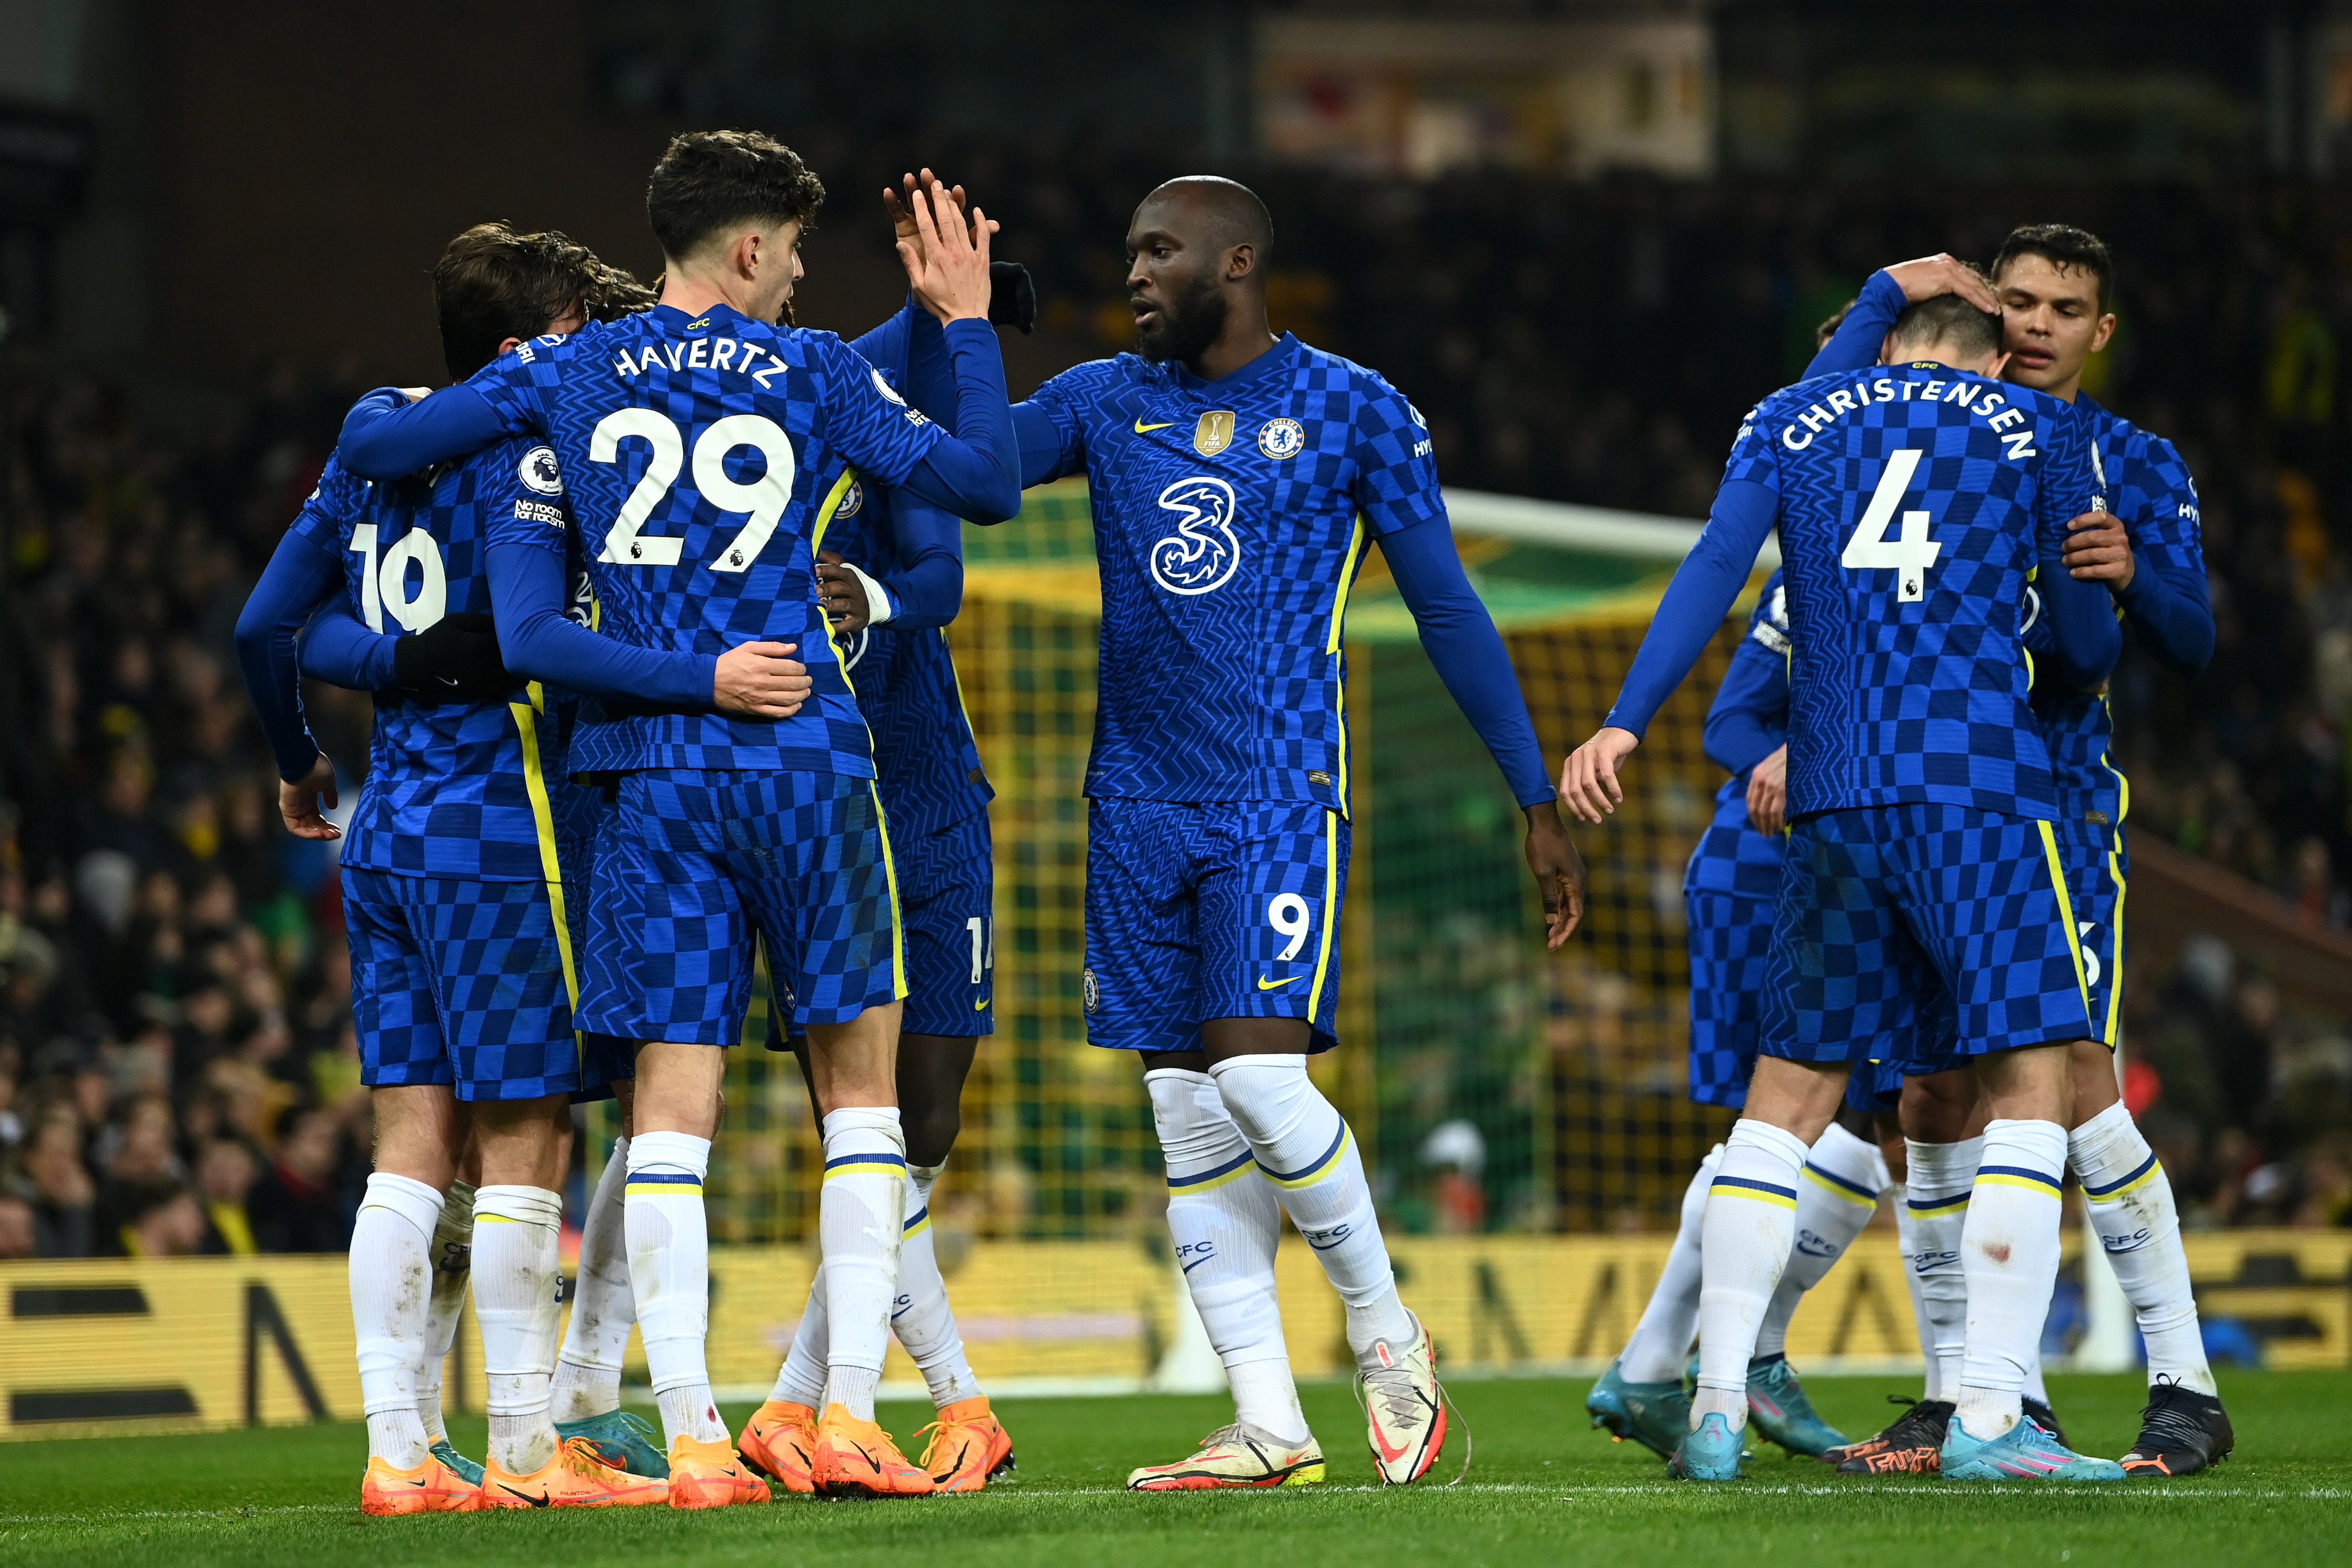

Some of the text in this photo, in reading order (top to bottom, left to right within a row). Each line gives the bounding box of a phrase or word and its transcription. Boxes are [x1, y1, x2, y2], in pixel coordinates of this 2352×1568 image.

[687, 318, 710, 330] CFC
[613, 338, 789, 390] HAVERTZ
[1912, 362, 1939, 370] CFC
[1269, 420, 1298, 430] CHELSEA
[1782, 378, 2037, 461] CHRISTENSEN
[1264, 448, 1282, 457] FOOTBALL
[589, 407, 795, 573] 29
[517, 500, 562, 519] No room
[514, 509, 565, 529] for racism
[1841, 449, 1942, 602] 4
[1268, 892, 1310, 961] 9
[1302, 1224, 1350, 1241] CFC
[2102, 1228, 2149, 1245] CFC
[444, 1242, 471, 1255] CF
[1175, 1241, 1213, 1258] CFC
[1800, 1229, 1838, 1254] CFC
[1914, 1251, 1958, 1263] CFC
